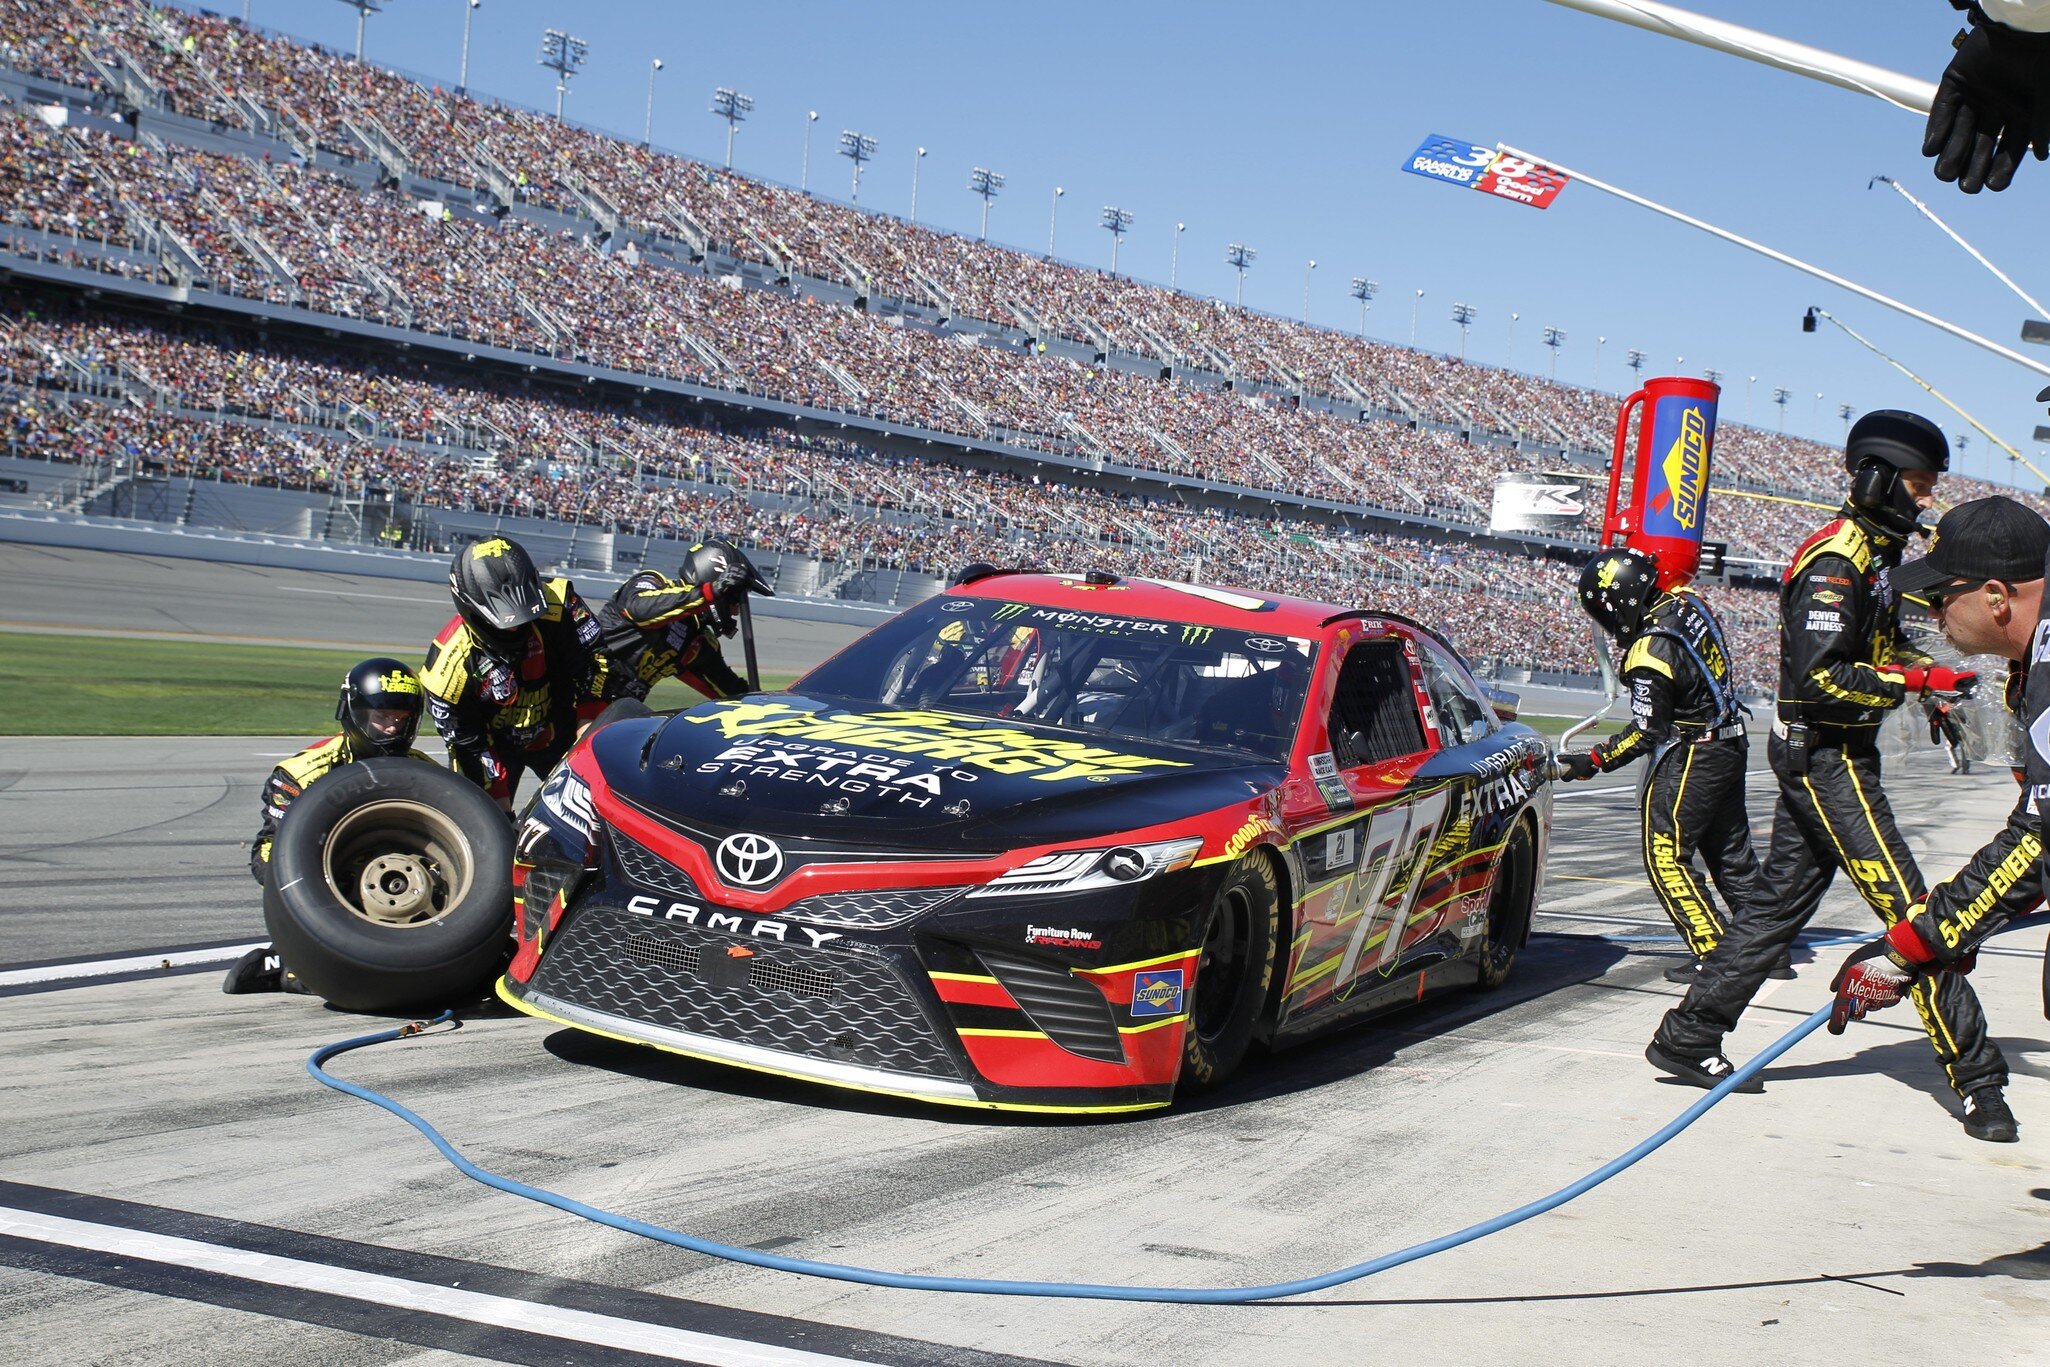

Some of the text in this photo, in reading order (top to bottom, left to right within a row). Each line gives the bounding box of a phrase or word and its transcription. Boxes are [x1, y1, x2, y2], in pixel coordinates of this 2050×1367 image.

[1414, 157, 1473, 175] CAMPING
[1414, 161, 1470, 182] WORLD
[1494, 186, 1533, 203] Sam
[1496, 177, 1544, 196] Good
[1676, 412, 1703, 525] SUNOCO
[531, 604, 540, 614] 77
[1813, 591, 1843, 602] SUNOCO
[504, 615, 516, 623] 77
[1032, 609, 1169, 635] MONSTER
[1055, 623, 1133, 636] ENERGY
[1805, 620, 1846, 632] MATTRESS
[1808, 610, 1841, 622] DENVER
[777, 721, 1143, 782] ENERGY
[829, 711, 1195, 768] 5-hour
[713, 746, 942, 796] EXTRA
[732, 738, 979, 783] UPGRADE TO
[1470, 740, 1528, 779] UPGRADE
[695, 761, 933, 809] STRENGTH
[1460, 773, 1529, 821] EXTRA
[519, 818, 551, 854] 77
[1225, 814, 1284, 857] GOODYEA
[1653, 832, 1691, 898] ENERGY
[1336, 786, 1451, 990] 77
[1852, 858, 1898, 928] 5-ho
[627, 894, 844, 949] CAMRY
[1027, 924, 1093, 941] Furniture Row
[1678, 898, 1718, 953] 5-hour
[1939, 888, 1997, 949] 5-hour
[1137, 986, 1179, 1001] SUNOCO
[1861, 965, 1912, 988] Mecha
